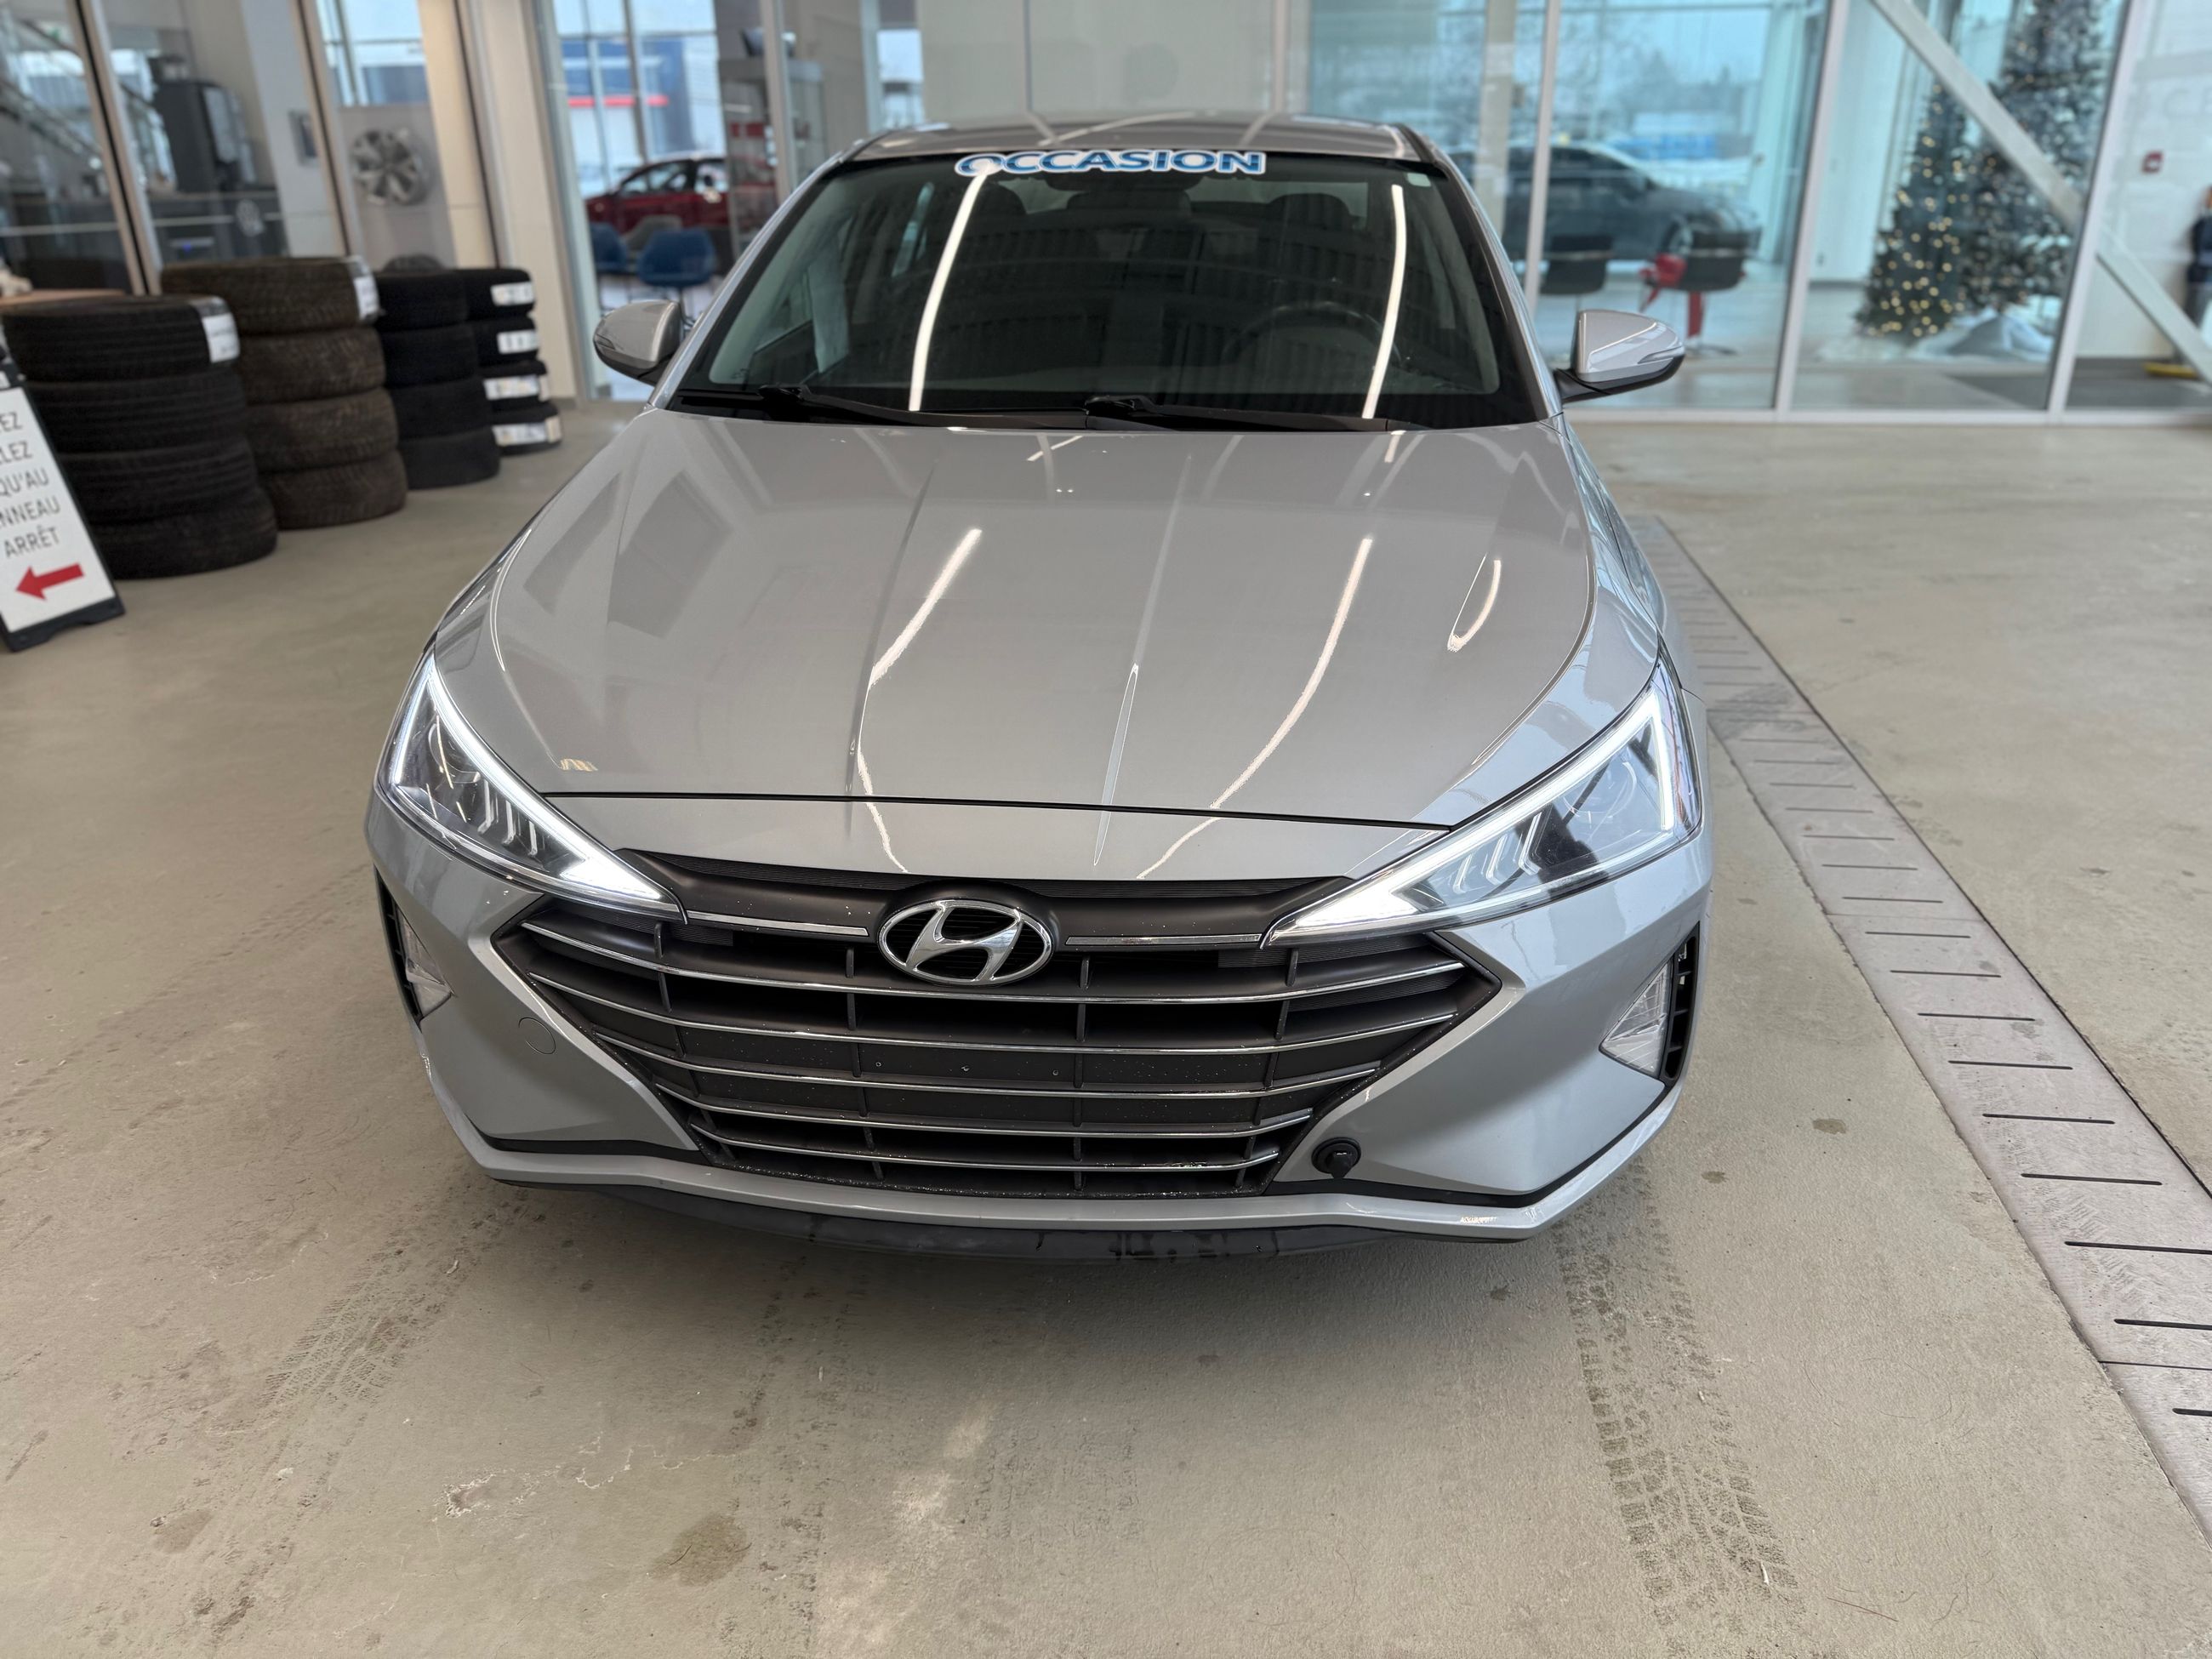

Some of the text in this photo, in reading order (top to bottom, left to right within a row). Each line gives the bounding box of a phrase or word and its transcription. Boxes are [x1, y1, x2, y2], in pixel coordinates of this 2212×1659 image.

[955, 150, 1265, 175] OCCASION
[0, 412, 23, 432] EZ
[0, 441, 33, 465] LEZ
[0, 495, 61, 527] NNEAU
[4, 525, 60, 558] ARRÊT
